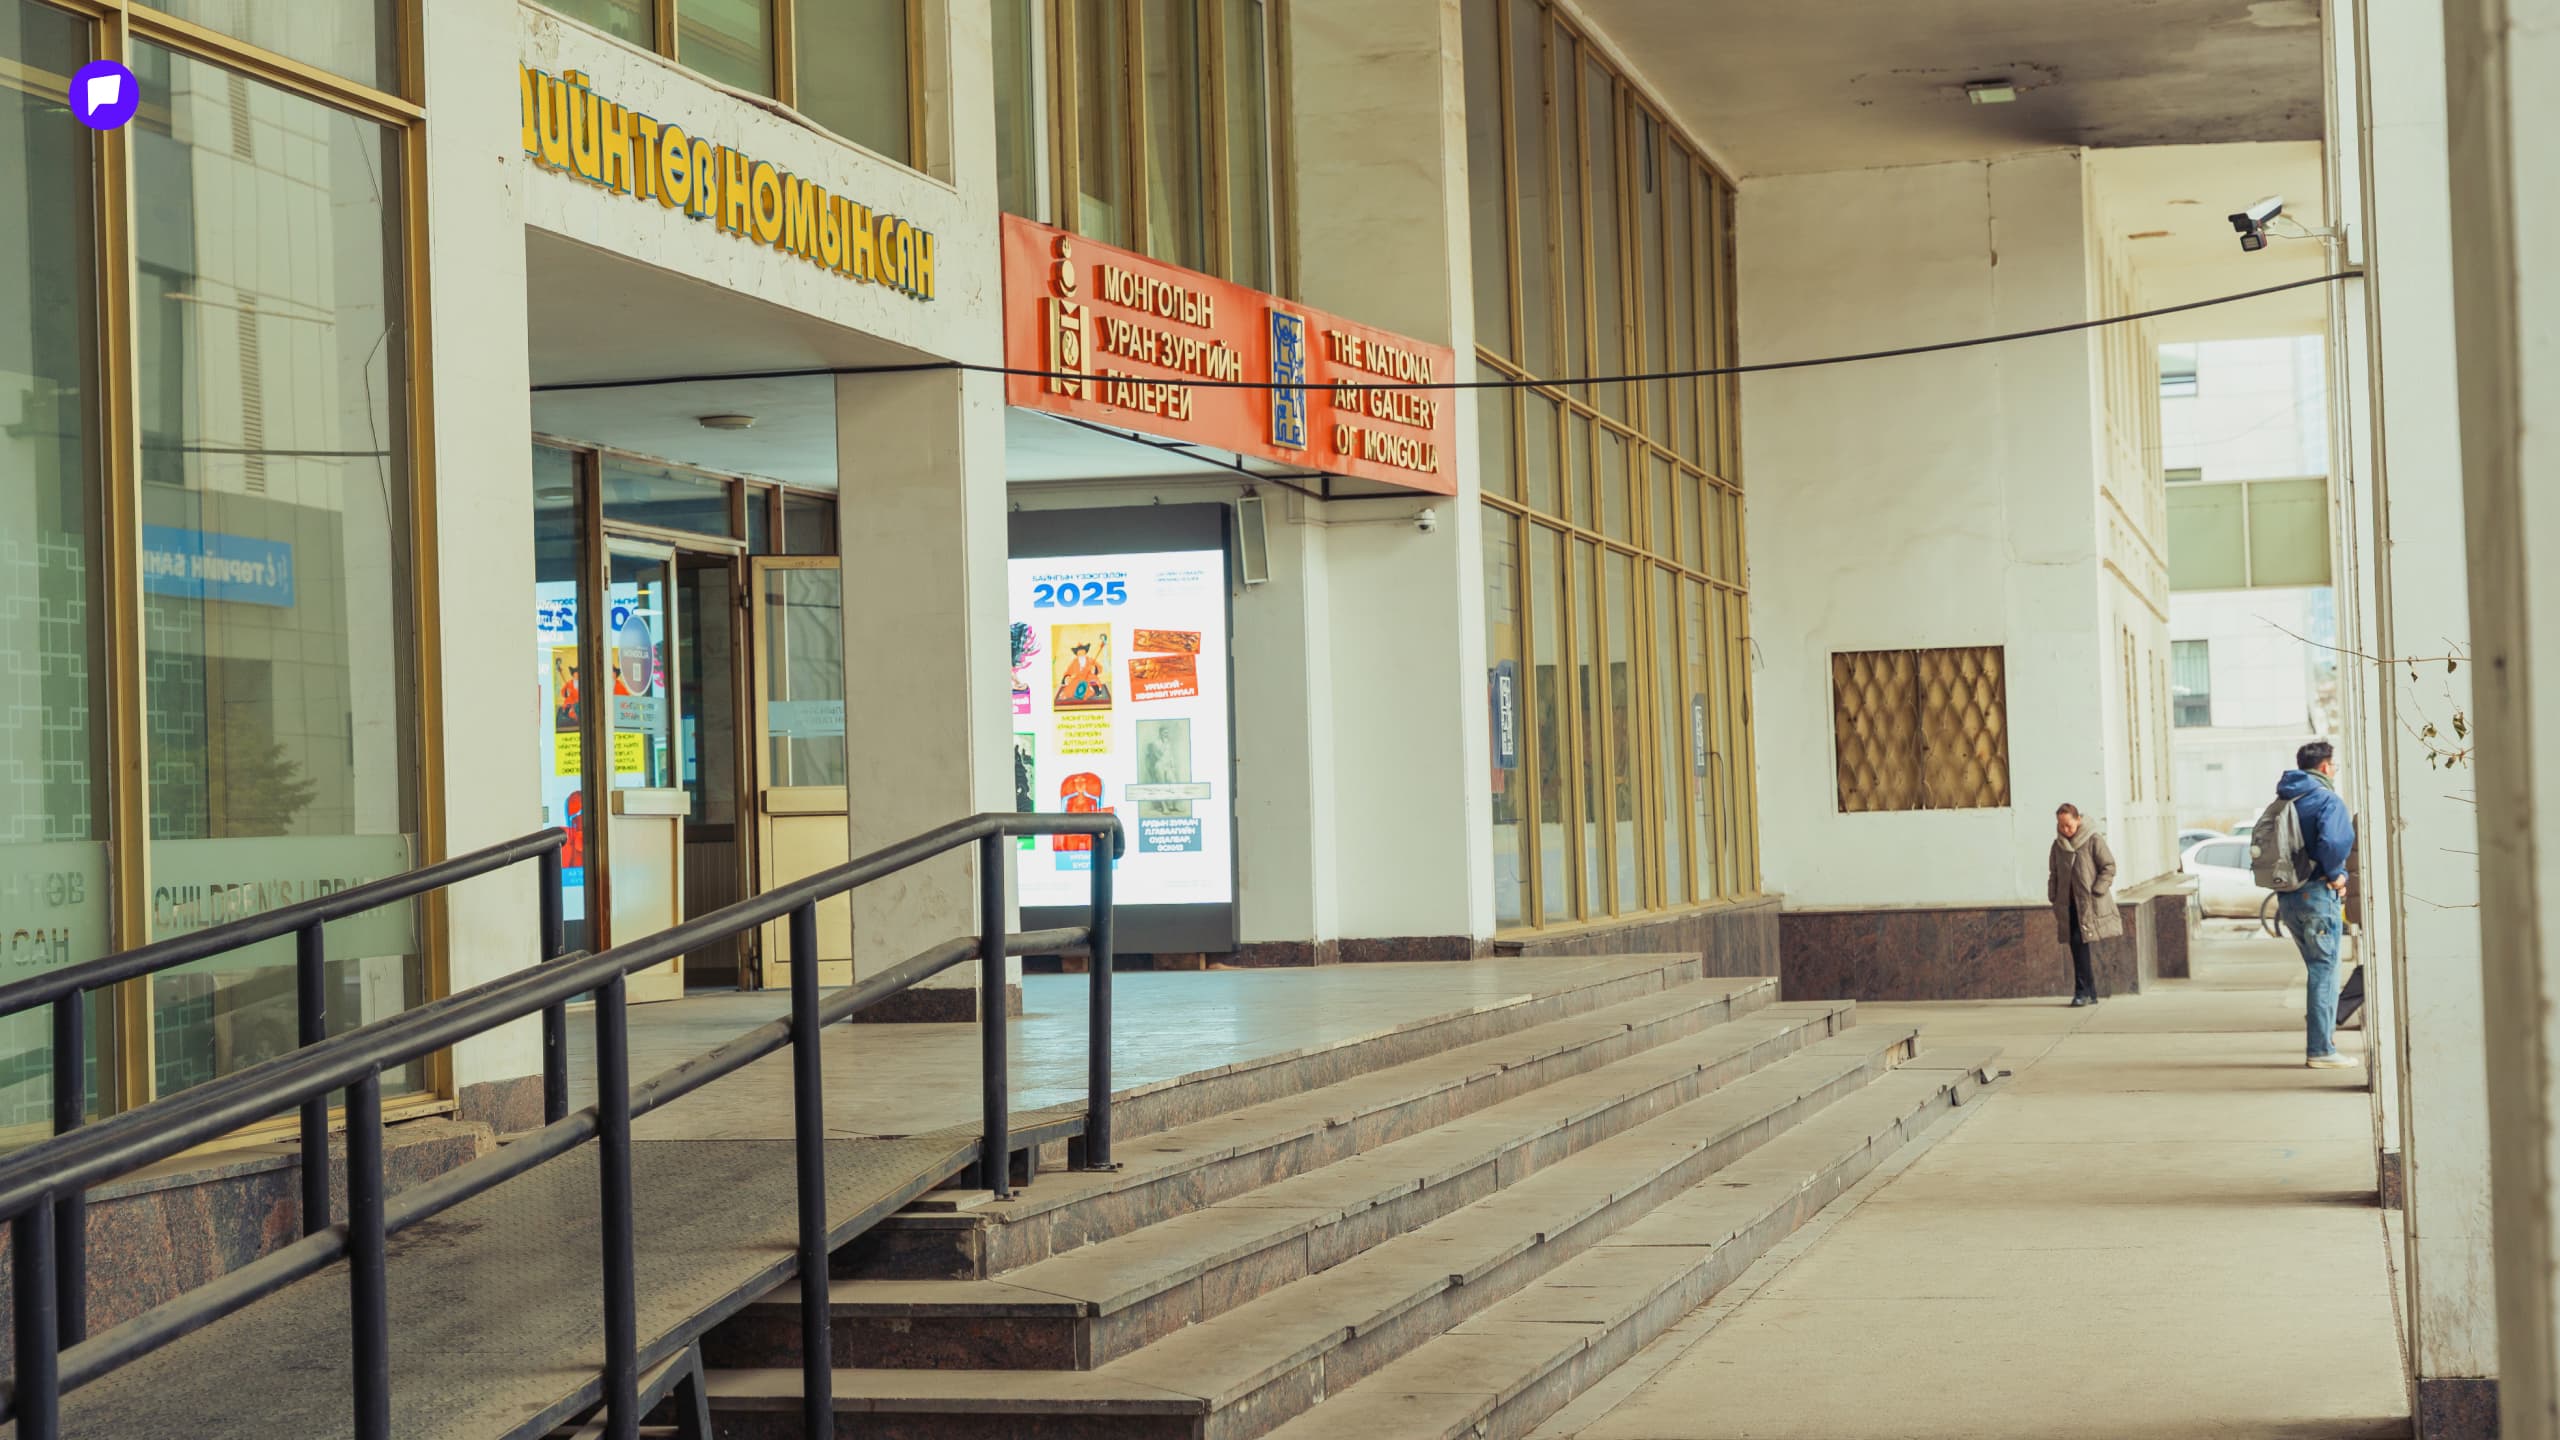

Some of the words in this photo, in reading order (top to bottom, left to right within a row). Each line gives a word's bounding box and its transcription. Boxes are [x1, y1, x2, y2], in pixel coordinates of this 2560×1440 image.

[631, 111, 718, 220] ТӨВ
[717, 144, 875, 284] НОМЫН
[875, 213, 935, 301] САН
[1103, 264, 1215, 329] МОНГОЛЫН
[1107, 317, 1157, 364] УРАН
[1160, 328, 1243, 384] ЗУРГИЙН
[1331, 329, 1362, 368] THE
[1364, 340, 1437, 385] NATIONAL
[1334, 378, 1366, 414] ART
[1369, 384, 1439, 430] GALLERY
[1336, 423, 1359, 456] OF
[1363, 427, 1439, 473] MONGOLIA
[1033, 580, 1128, 608] 2025
[11, 928, 70, 967] САН
